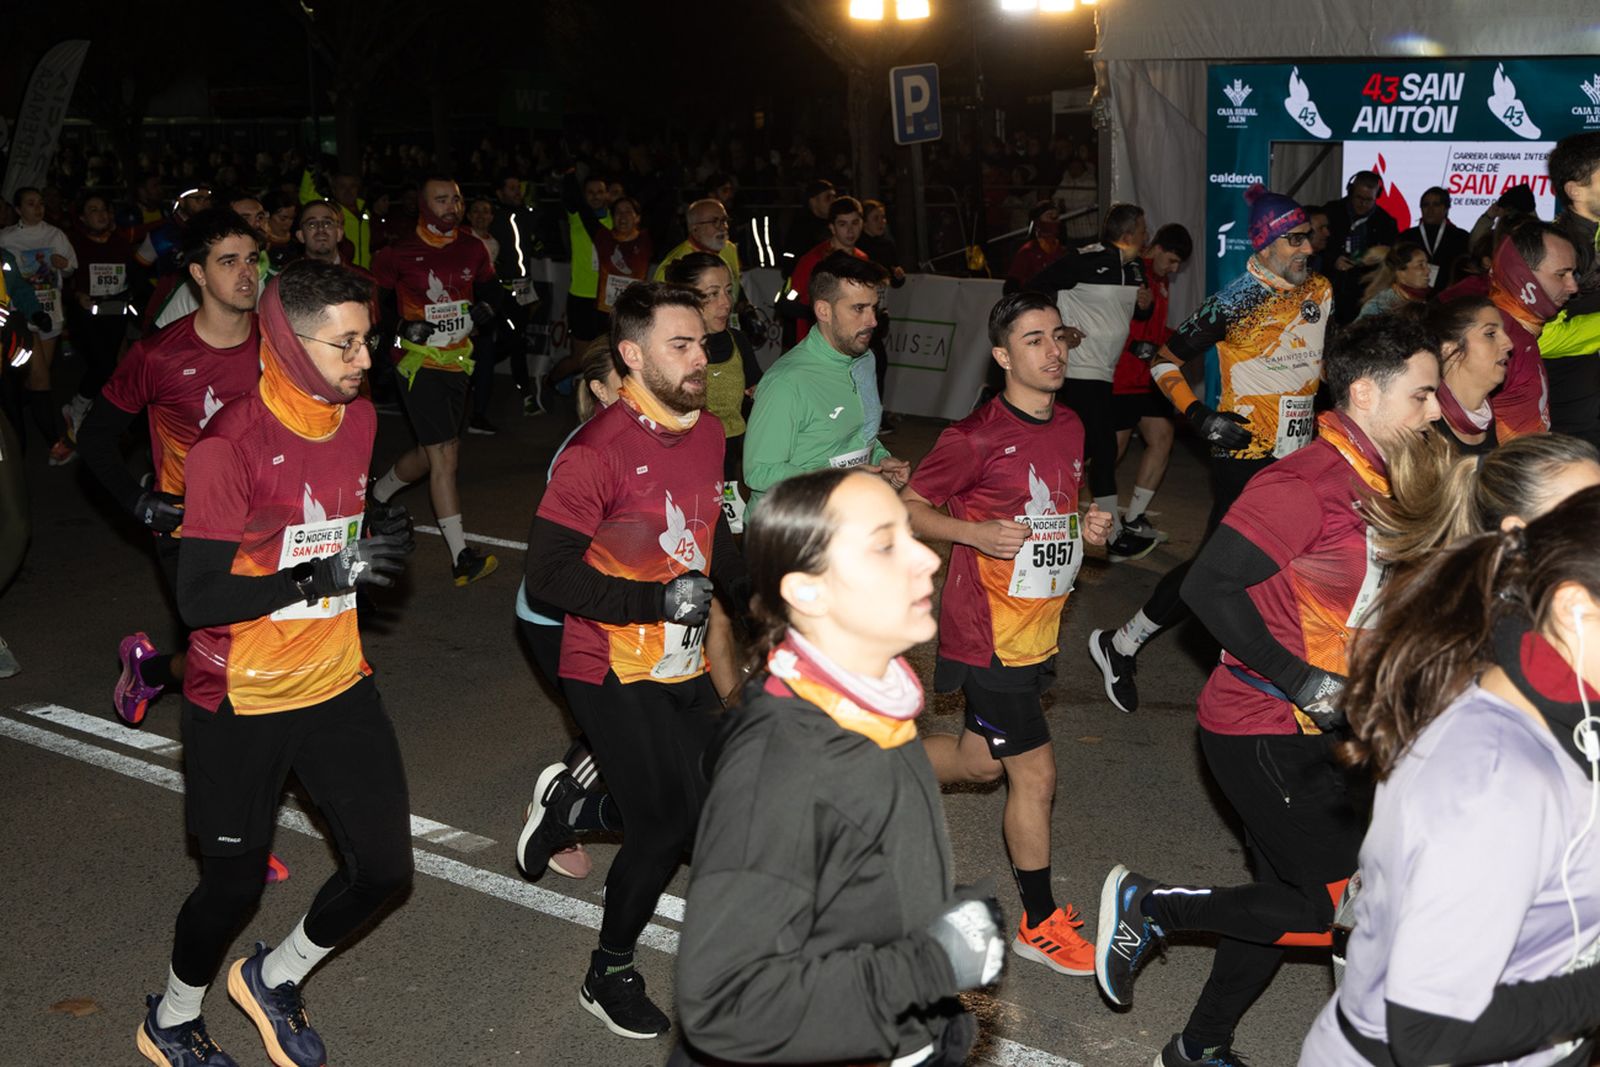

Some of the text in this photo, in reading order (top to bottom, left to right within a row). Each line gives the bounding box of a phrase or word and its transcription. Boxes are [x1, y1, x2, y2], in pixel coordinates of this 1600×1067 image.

[1362, 73, 1465, 103] 43 SAN
[902, 75, 930, 134] P
[1571, 106, 1592, 115] CAJA
[1298, 107, 1316, 126] 43
[1352, 98, 1458, 133] ANTÓN
[1503, 106, 1524, 127] 43
[1453, 152, 1488, 160] CARRERA
[1489, 152, 1521, 160] URBANA
[1451, 163, 1500, 172] NOCHE DE
[1209, 173, 1263, 184] calderón
[1448, 173, 1555, 197] SAN ANT
[1465, 198, 1489, 206] ENERO
[438, 317, 465, 332] 6511
[1033, 520, 1066, 530] NOCHE DE
[306, 531, 332, 543] NOCHE
[334, 530, 343, 540] DE
[292, 546, 312, 558] SAN
[674, 537, 695, 561] 43
[1033, 541, 1074, 568] 5957
